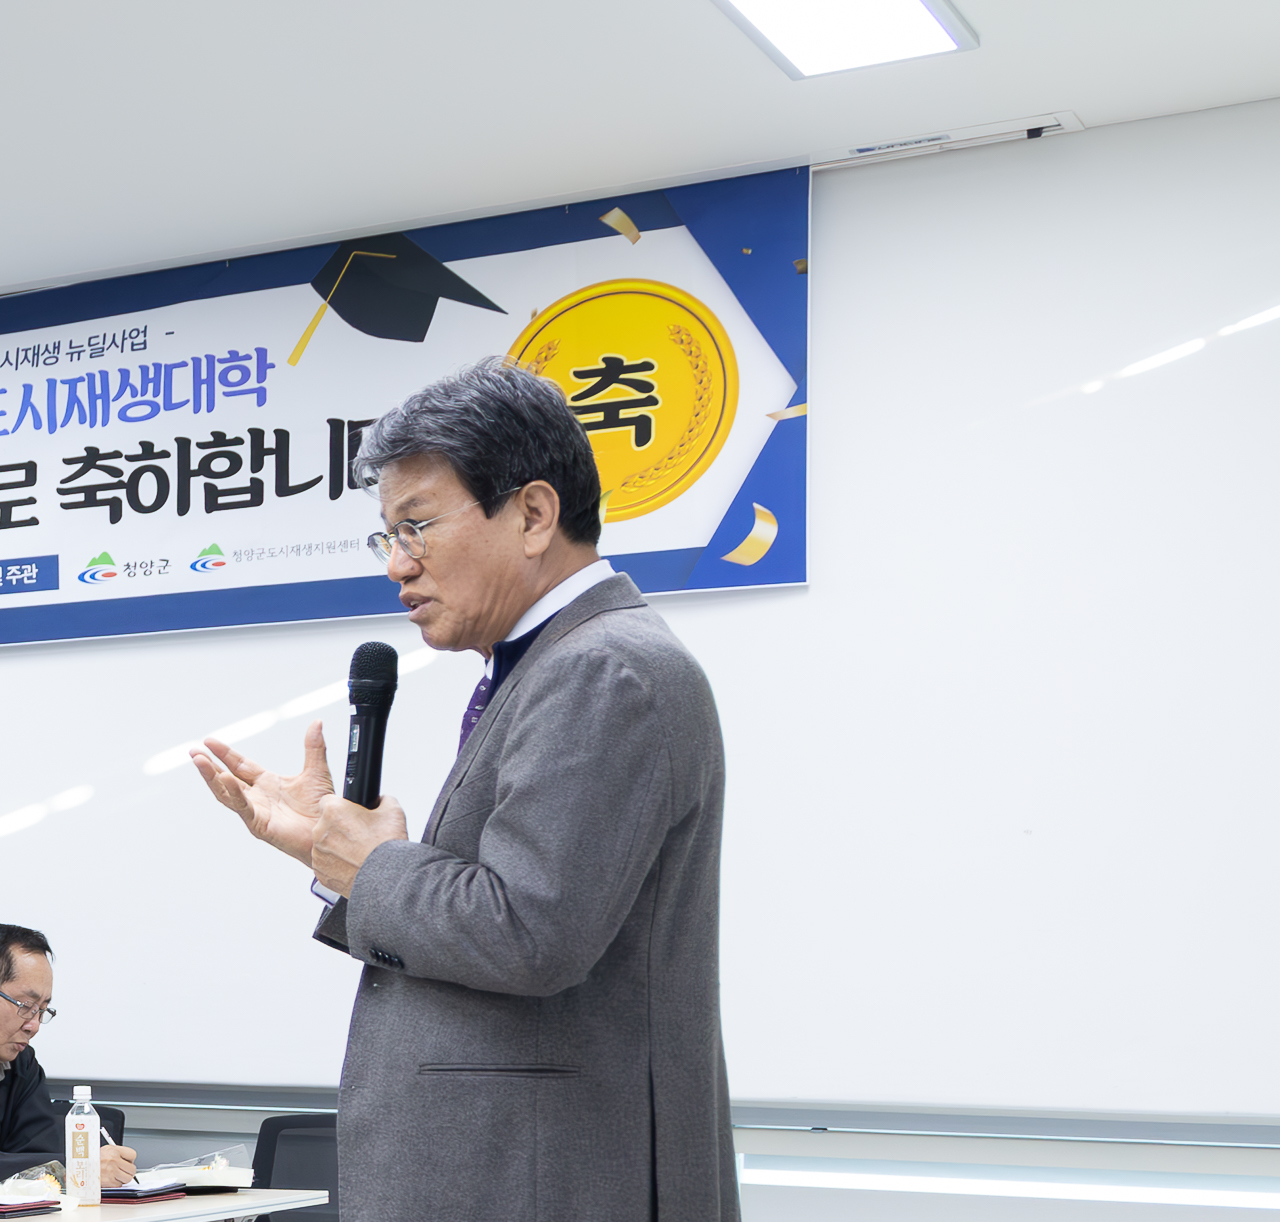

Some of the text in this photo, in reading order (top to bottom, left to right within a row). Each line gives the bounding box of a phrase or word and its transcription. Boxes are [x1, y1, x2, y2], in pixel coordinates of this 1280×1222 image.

[65, 325, 148, 363] 뉴딜사업
[568, 355, 660, 448] 축
[231, 537, 361, 563] 청양군도시재생지원센터
[5, 563, 39, 586] 주관
[123, 557, 172, 578] 청양군
